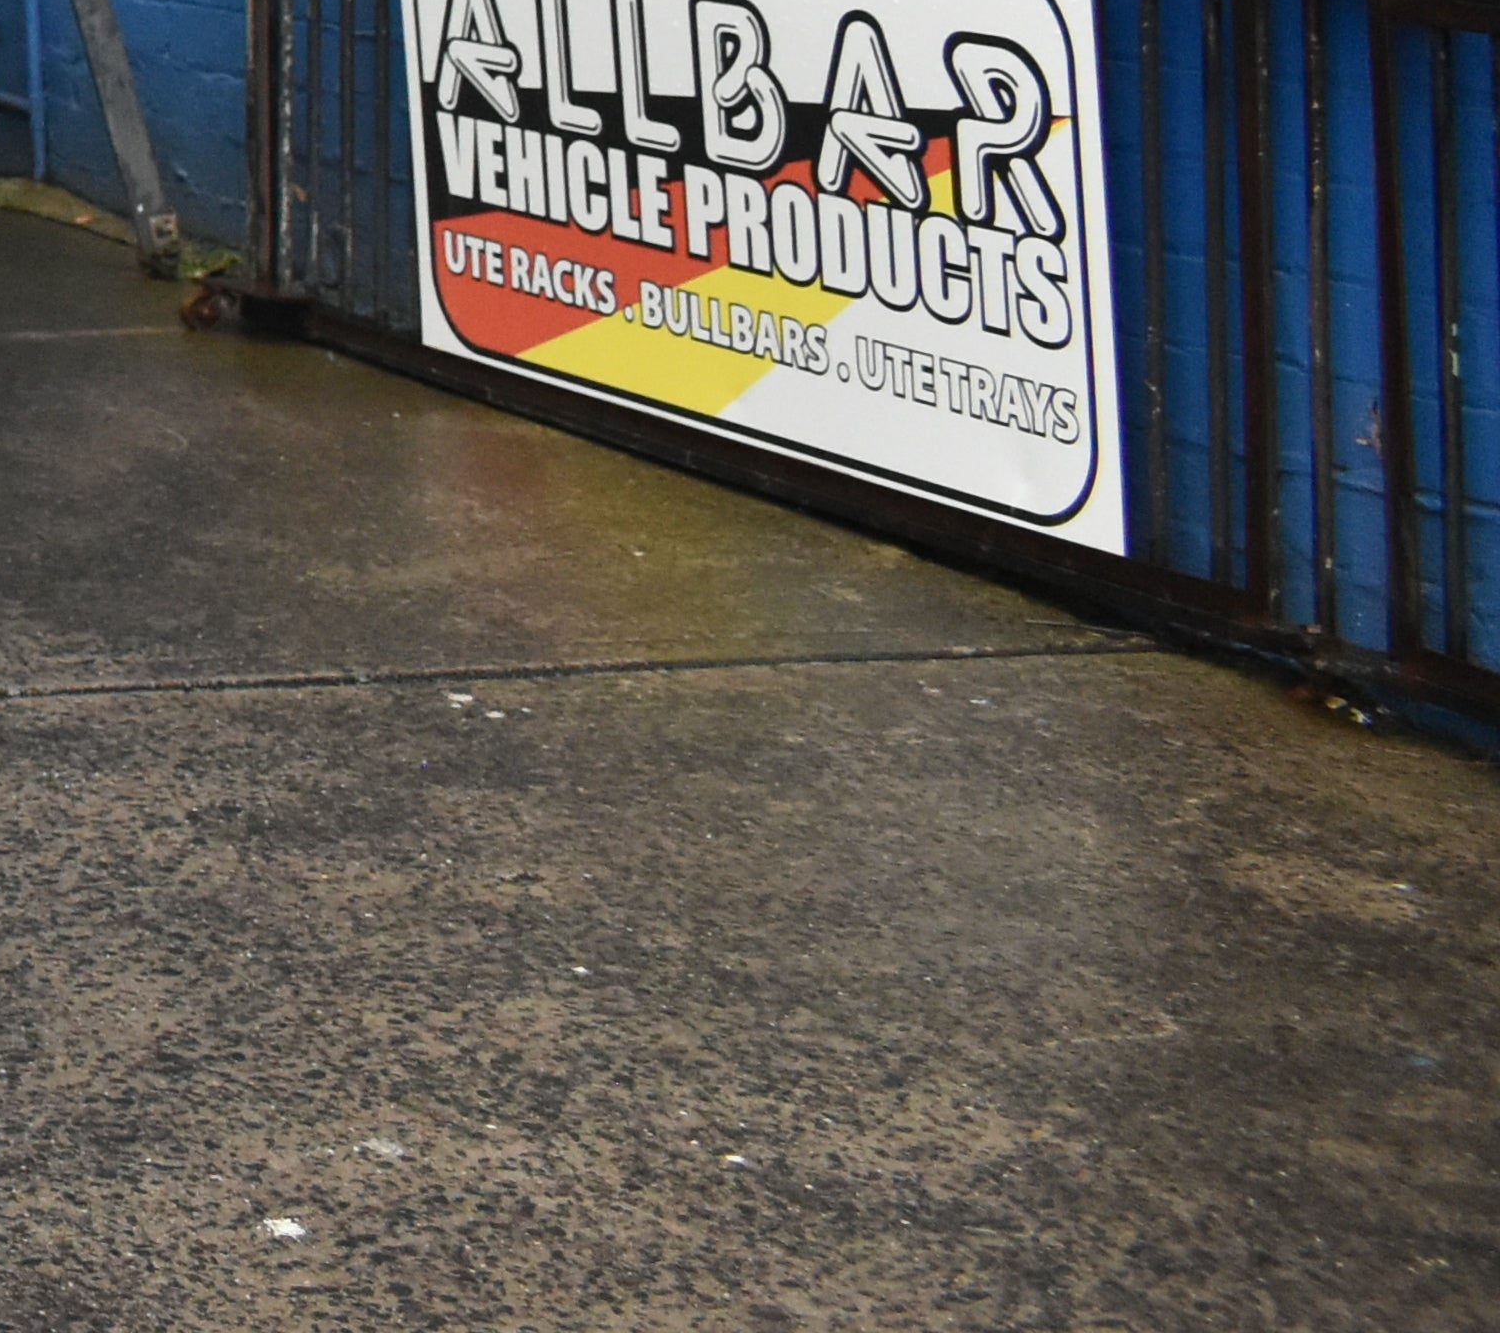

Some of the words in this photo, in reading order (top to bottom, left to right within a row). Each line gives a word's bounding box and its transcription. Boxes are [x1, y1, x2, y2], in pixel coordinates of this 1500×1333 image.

[436, 110, 675, 251] VEHICLE
[684, 166, 1074, 350] PRODUCTS
[442, 230, 504, 286] UTE
[509, 249, 615, 316] RACKS
[640, 288, 830, 376] BULLBARS
[855, 335, 941, 407] UTE
[941, 357, 1080, 445] TRAYS
